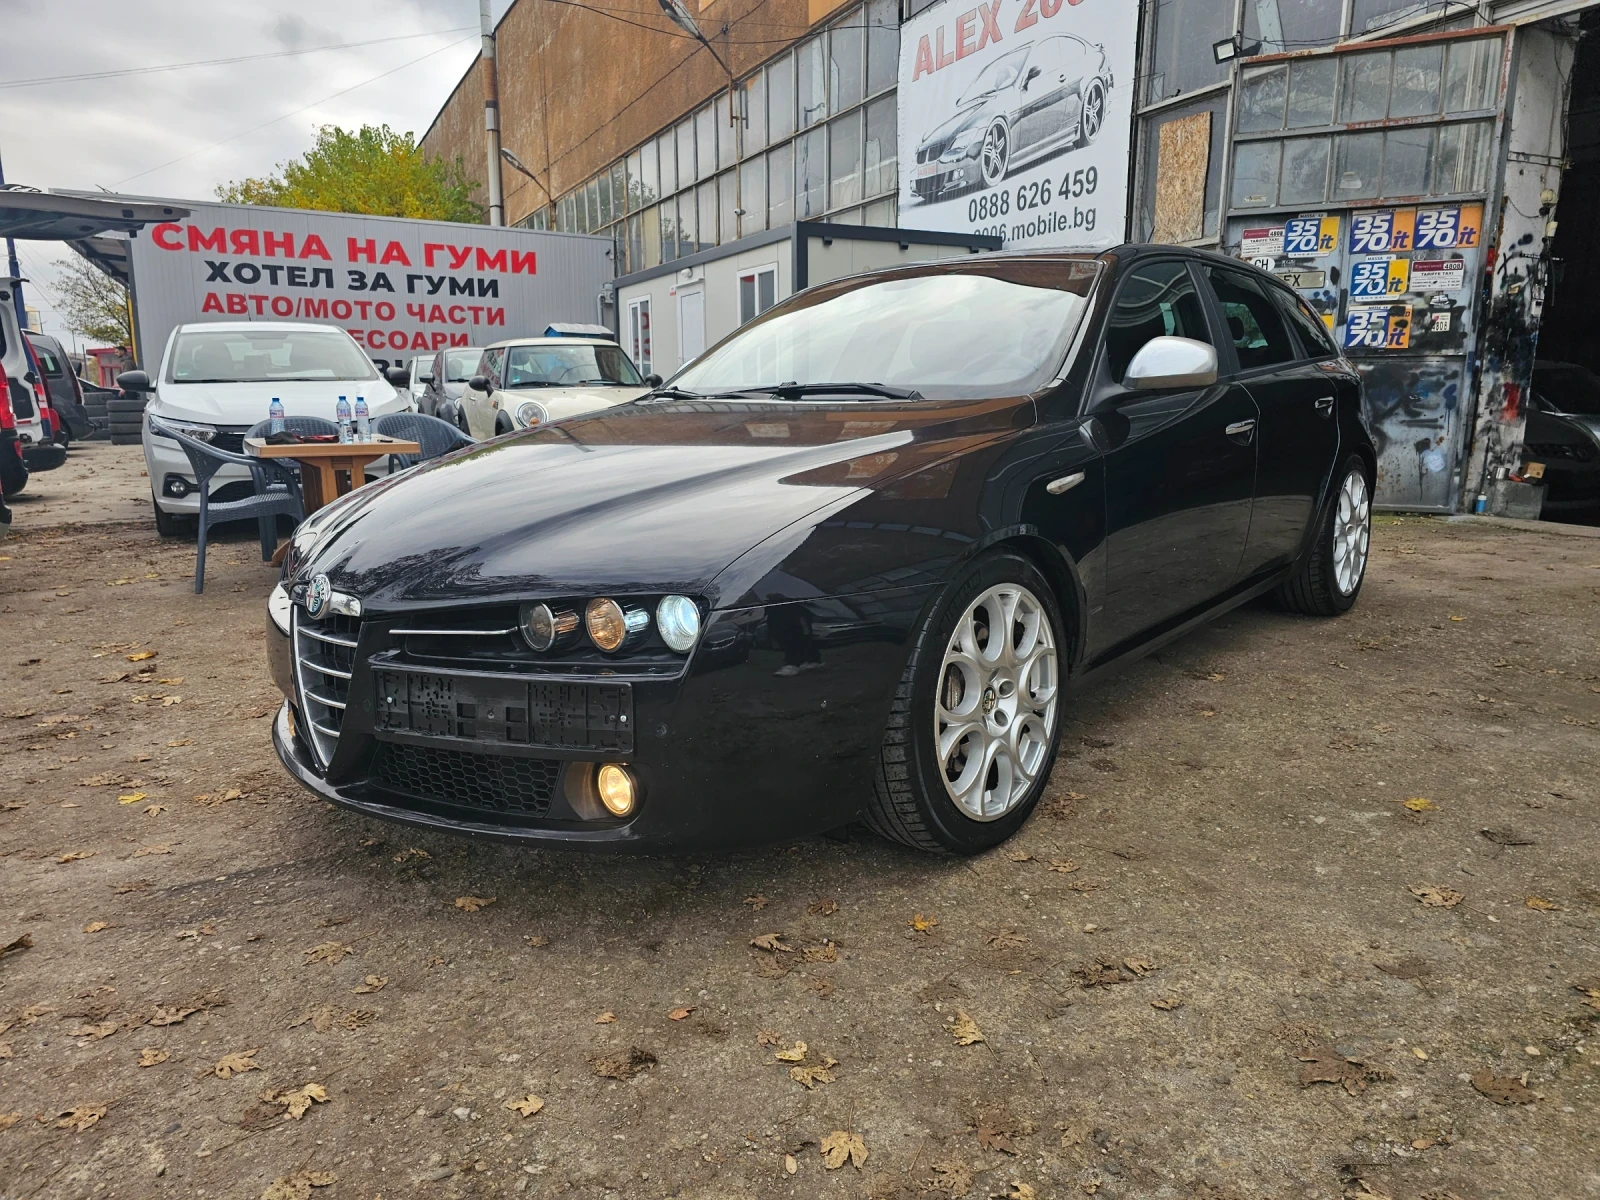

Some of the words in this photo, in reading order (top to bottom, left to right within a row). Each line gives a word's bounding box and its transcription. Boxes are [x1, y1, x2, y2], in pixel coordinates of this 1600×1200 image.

[912, 0, 1003, 82] ALEX
[969, 190, 1009, 223] 0888
[1016, 178, 1052, 211] 626
[1058, 166, 1098, 200] 459
[1288, 220, 1319, 237] 35
[1354, 215, 1391, 234] 35
[1418, 210, 1458, 229] 35
[151, 222, 332, 261] СМЯНА
[347, 237, 412, 267] НА
[424, 242, 537, 275] ГУМИ
[1354, 263, 1387, 280] 35
[1444, 262, 1461, 270] 4808
[204, 260, 334, 289] ХОТЕЛ
[347, 269, 396, 293] ЗА
[406, 273, 499, 298] ГУМИ
[201, 292, 396, 321] АВТО/МОТО
[406, 303, 505, 327] ЧАСТИ
[1350, 312, 1388, 330] 35
